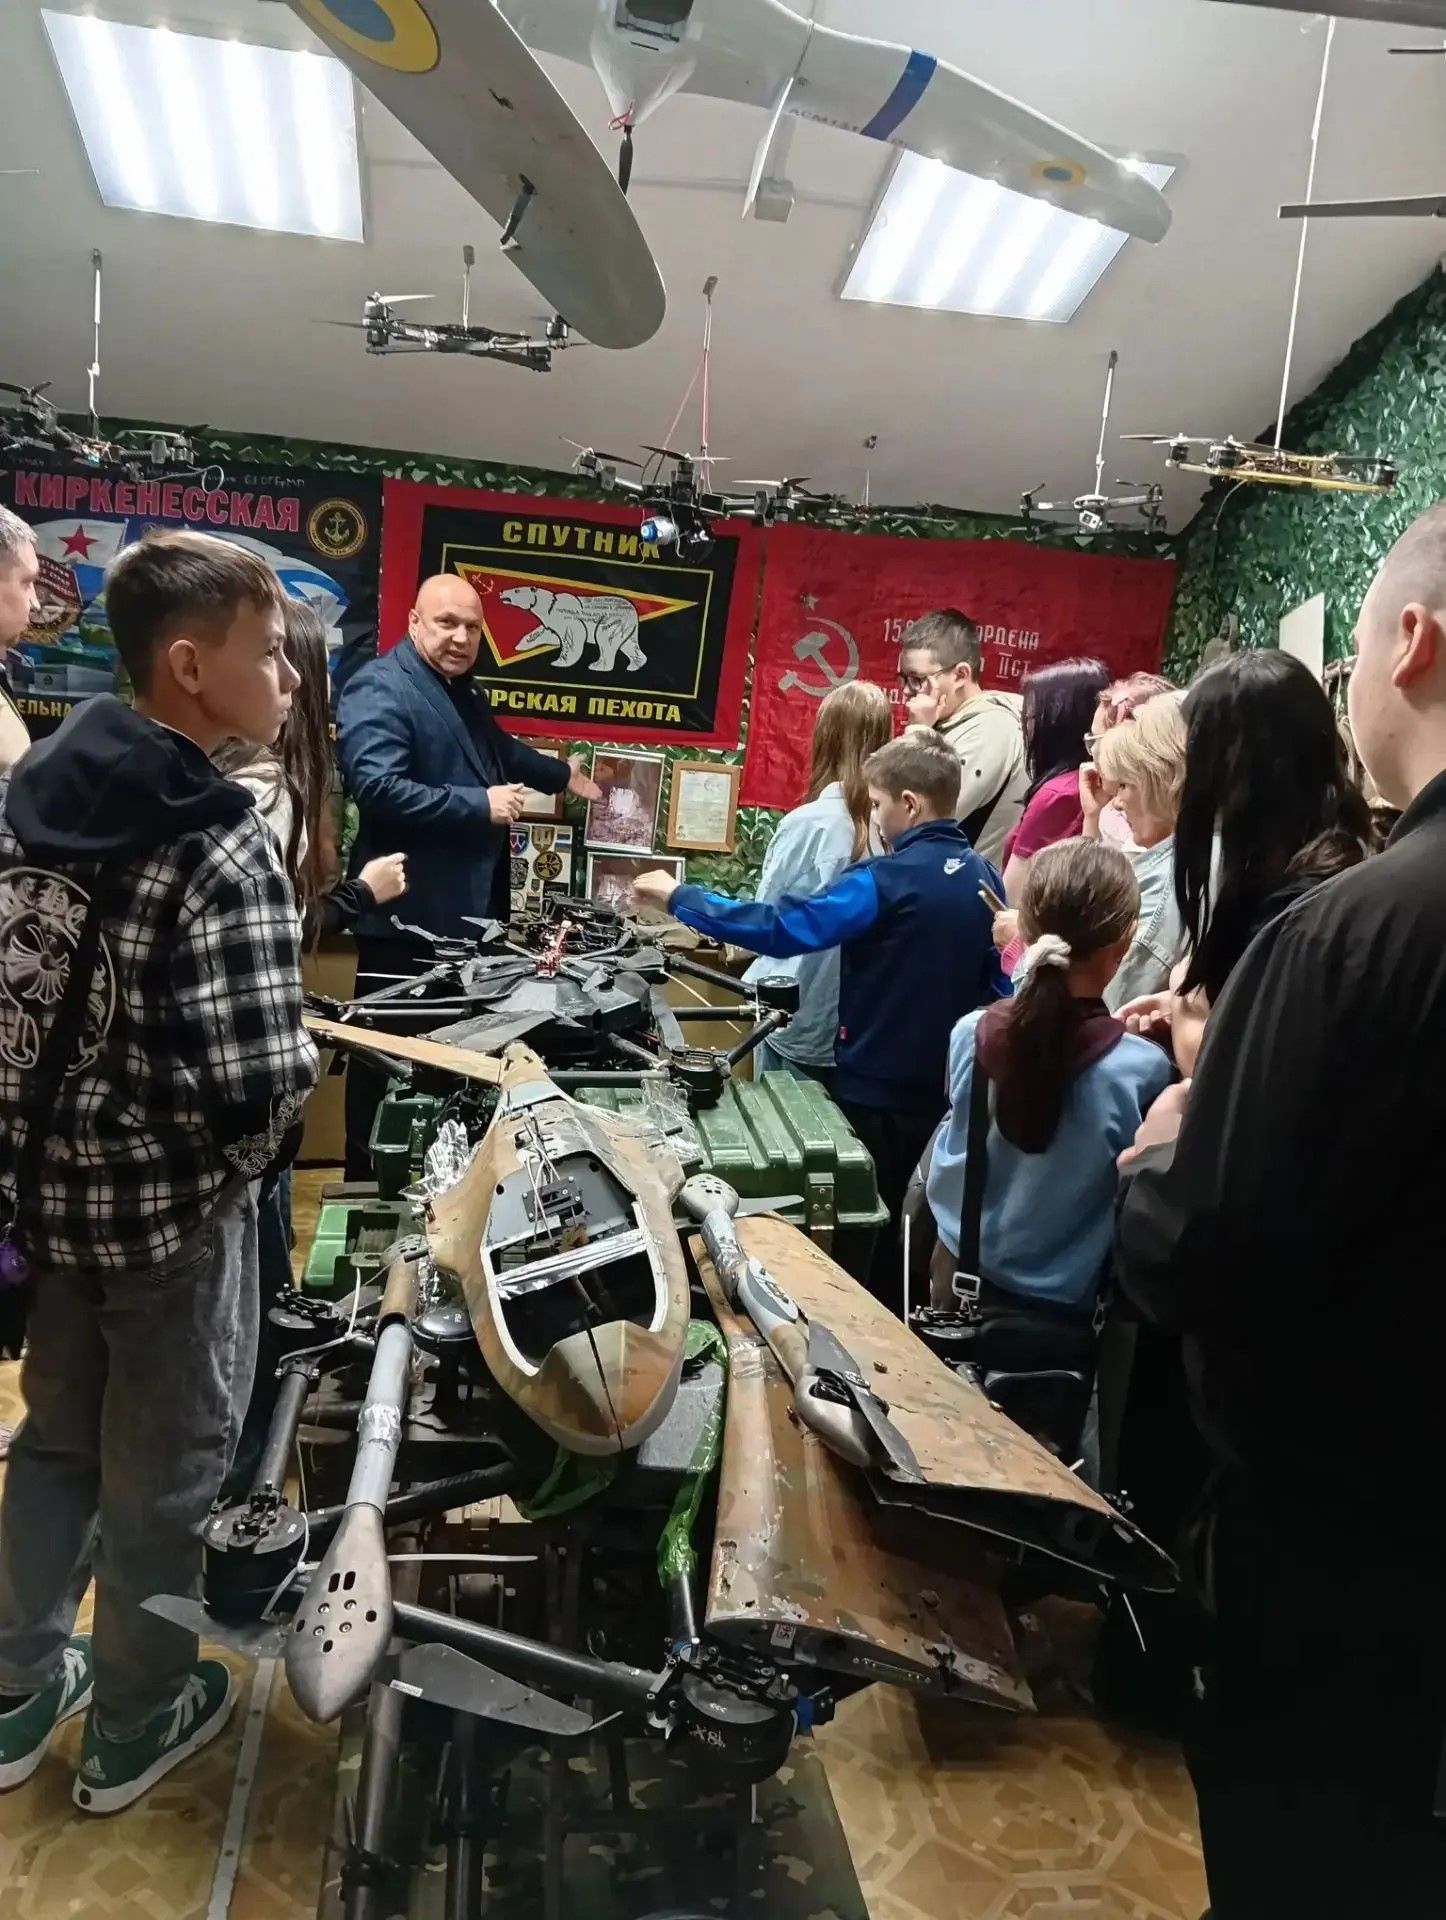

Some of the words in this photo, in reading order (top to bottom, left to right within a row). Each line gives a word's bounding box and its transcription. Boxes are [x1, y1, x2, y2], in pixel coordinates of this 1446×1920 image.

[15, 470, 300, 532] КИРКЕНЕССКАЯ
[502, 521, 660, 559] СПУТНИК
[484, 688, 576, 713] РСКАЯ
[588, 697, 682, 723] ПЕХОТА
